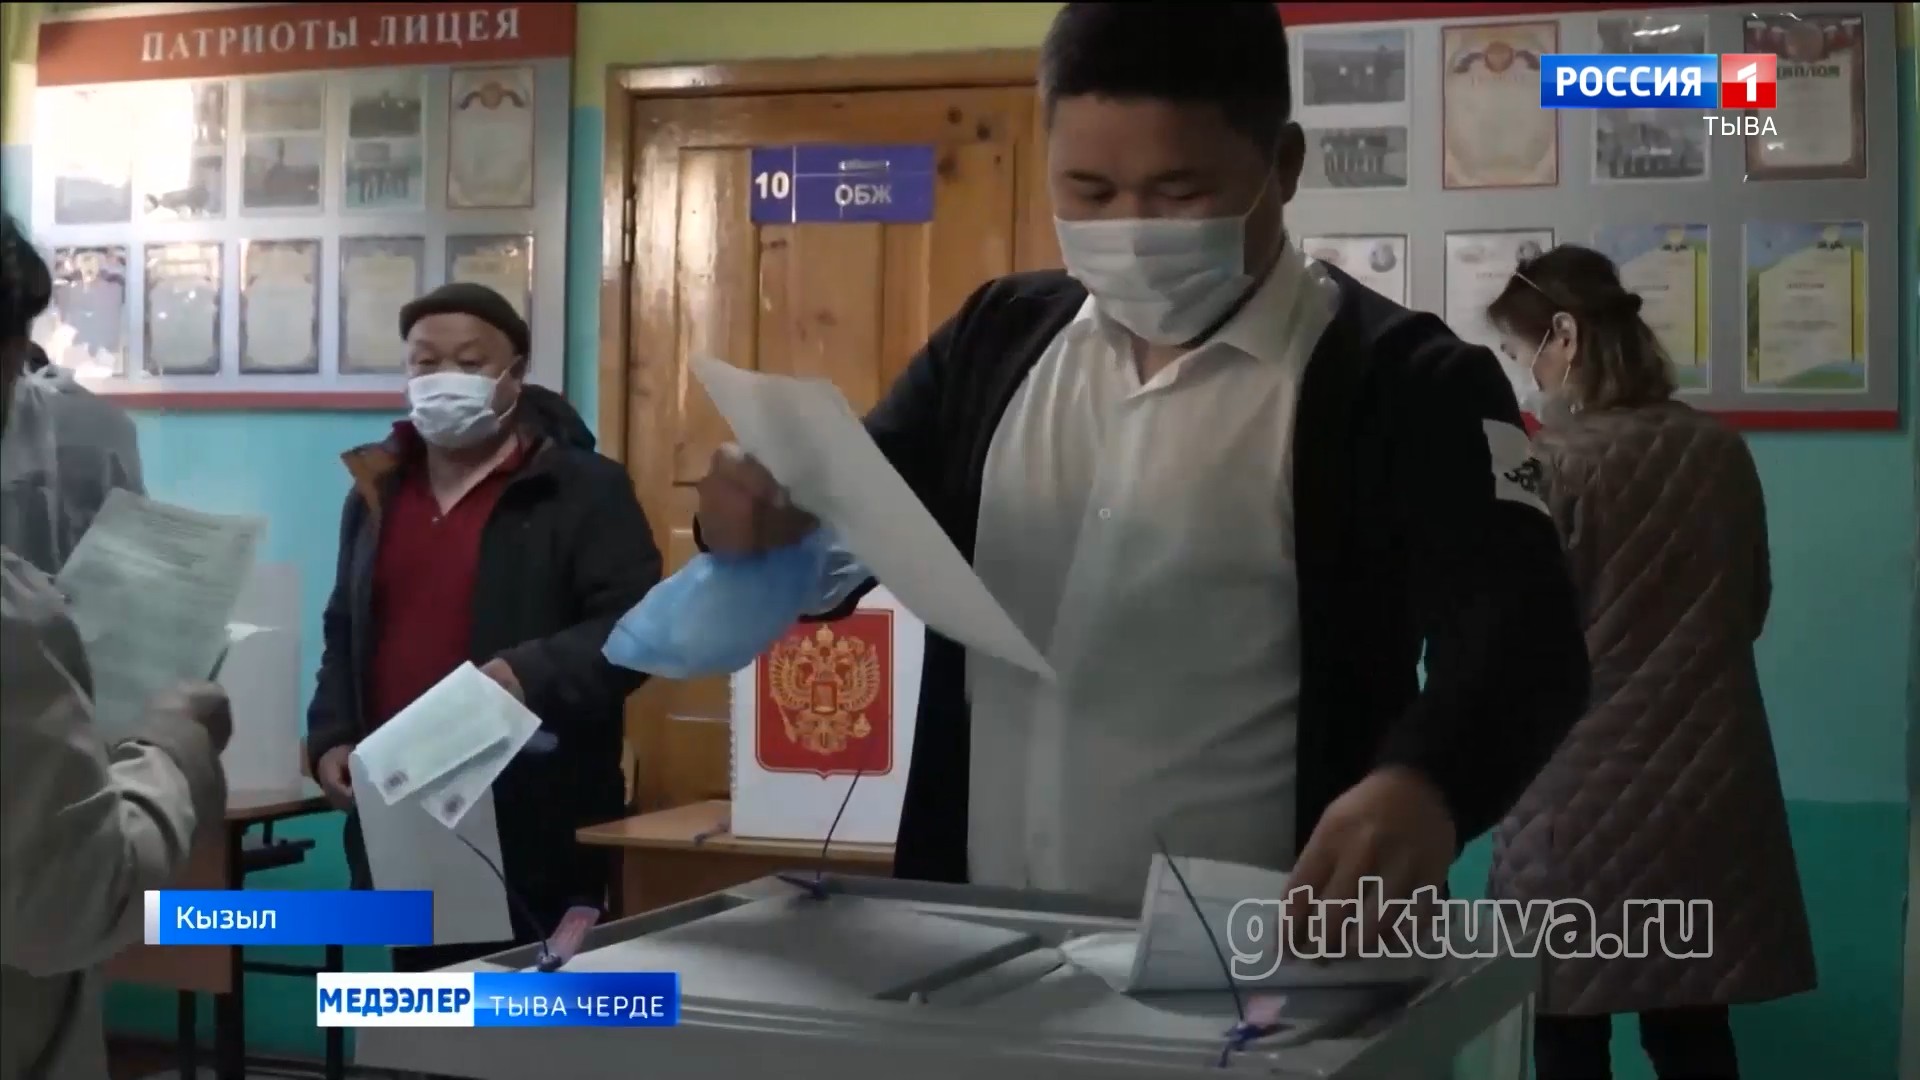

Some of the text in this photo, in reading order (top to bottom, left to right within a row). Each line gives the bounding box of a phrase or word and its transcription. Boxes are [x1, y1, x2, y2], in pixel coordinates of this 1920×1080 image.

[141, 7, 520, 63] ПАТРИОТЫ ЛИЦЕЯ
[755, 171, 790, 199] 10
[834, 184, 892, 205] ОБЖ
